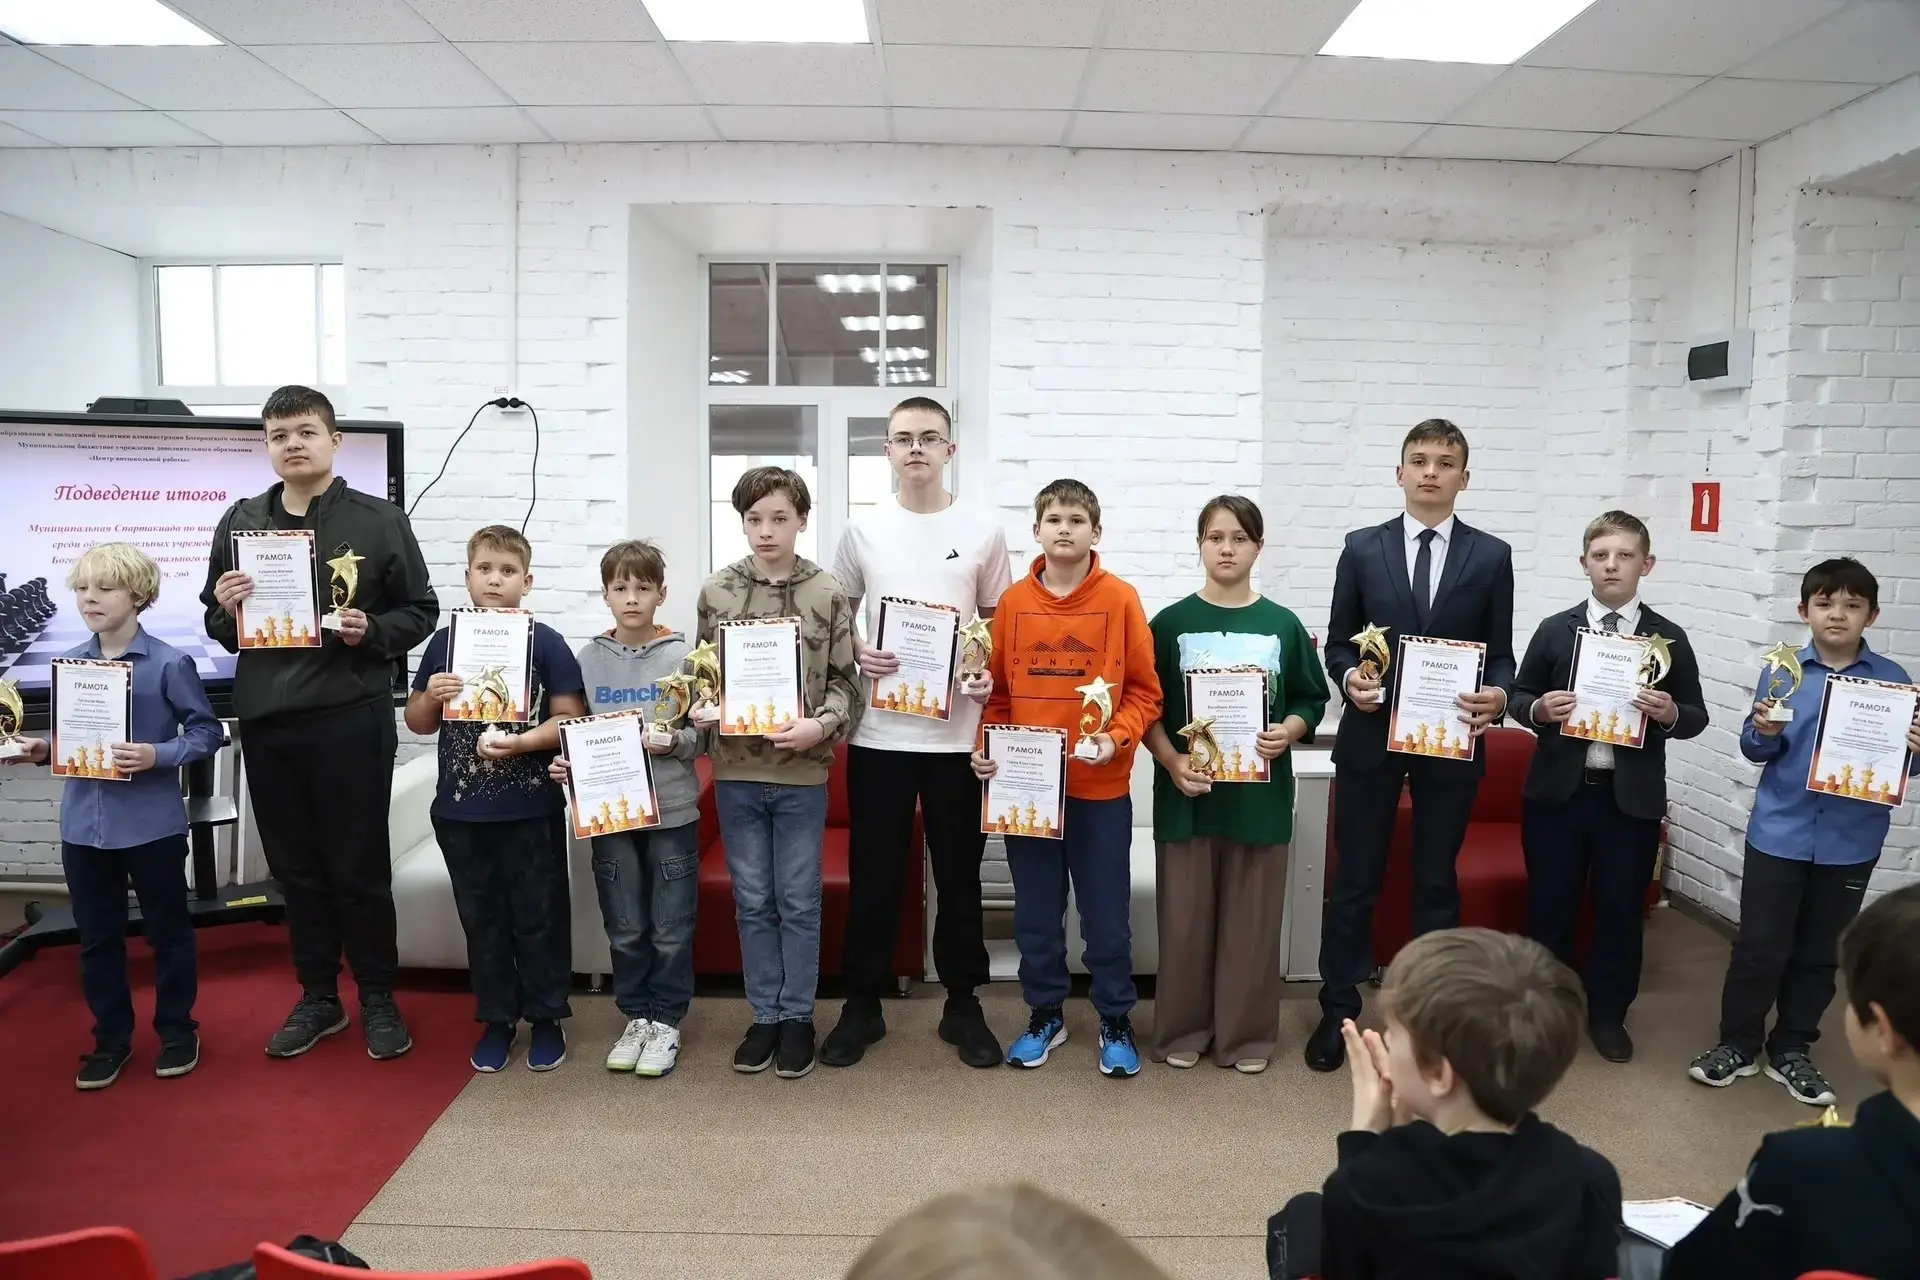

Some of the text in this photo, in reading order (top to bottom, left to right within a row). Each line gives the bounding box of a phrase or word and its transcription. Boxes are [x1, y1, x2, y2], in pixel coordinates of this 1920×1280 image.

[54, 484, 227, 502] Подведение итогов
[28, 524, 112, 534] Муниципальная
[114, 524, 181, 534] Спартакиада
[52, 540, 80, 552] среди
[473, 628, 510, 636] ГРАМОТА
[901, 621, 937, 633] ГРАМОТА
[742, 641, 778, 649] ГРАМОТА
[1597, 651, 1632, 663] ГРАМОТА
[1422, 660, 1459, 671] ГРАМОТА
[75, 682, 109, 691] ГРАМОТА
[1849, 700, 1892, 714] ГРАМОТА
[585, 735, 623, 747] ГРАМОТА
[1007, 745, 1043, 755] ГРАМОТА
